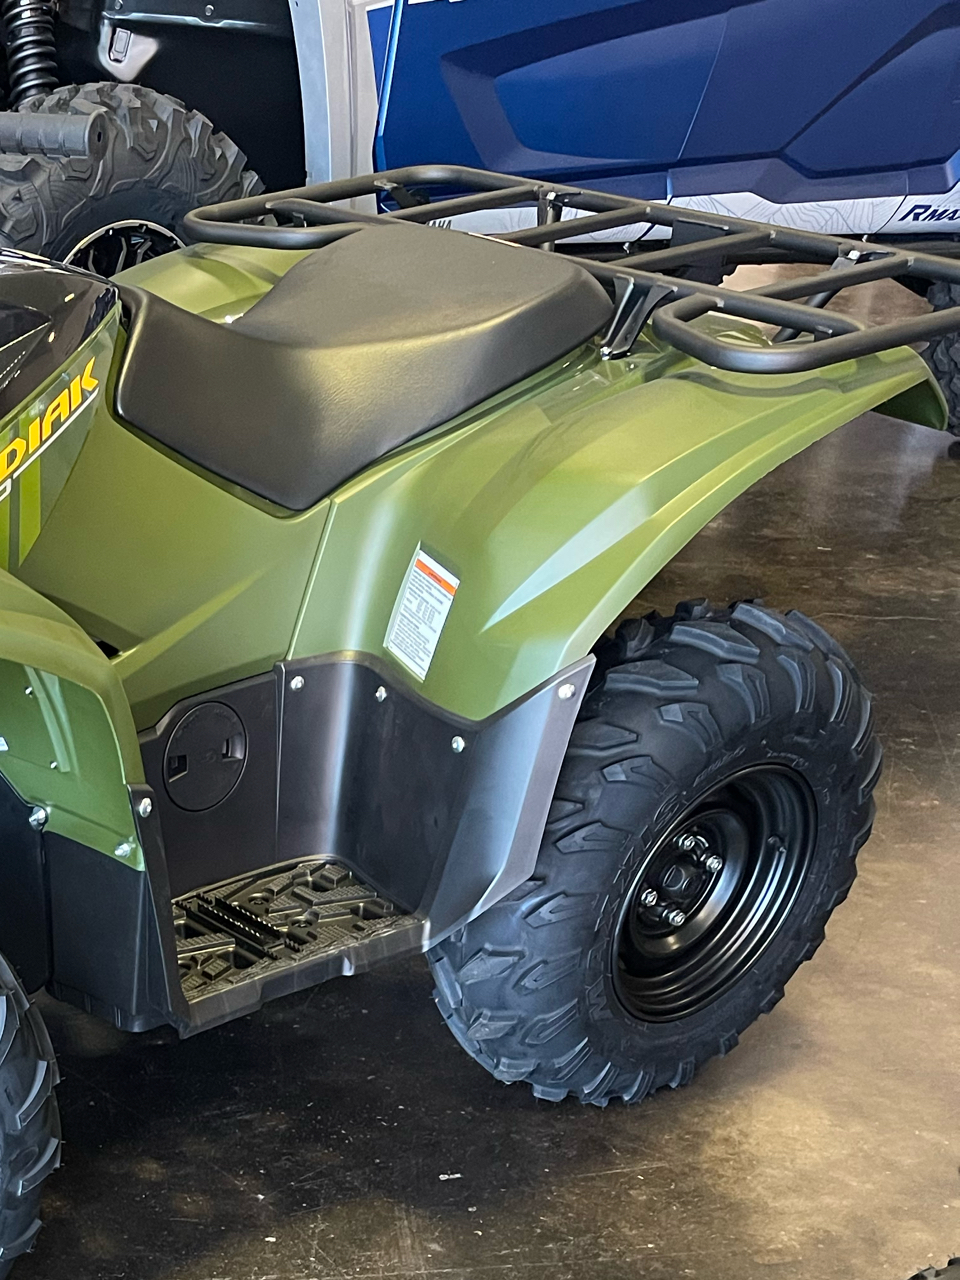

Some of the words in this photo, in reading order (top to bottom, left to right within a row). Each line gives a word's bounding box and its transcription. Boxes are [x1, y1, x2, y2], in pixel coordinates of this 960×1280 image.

[898, 204, 960, 222] RMA
[426, 219, 452, 230] AHA
[585, 792, 681, 1024] MAXXIS
